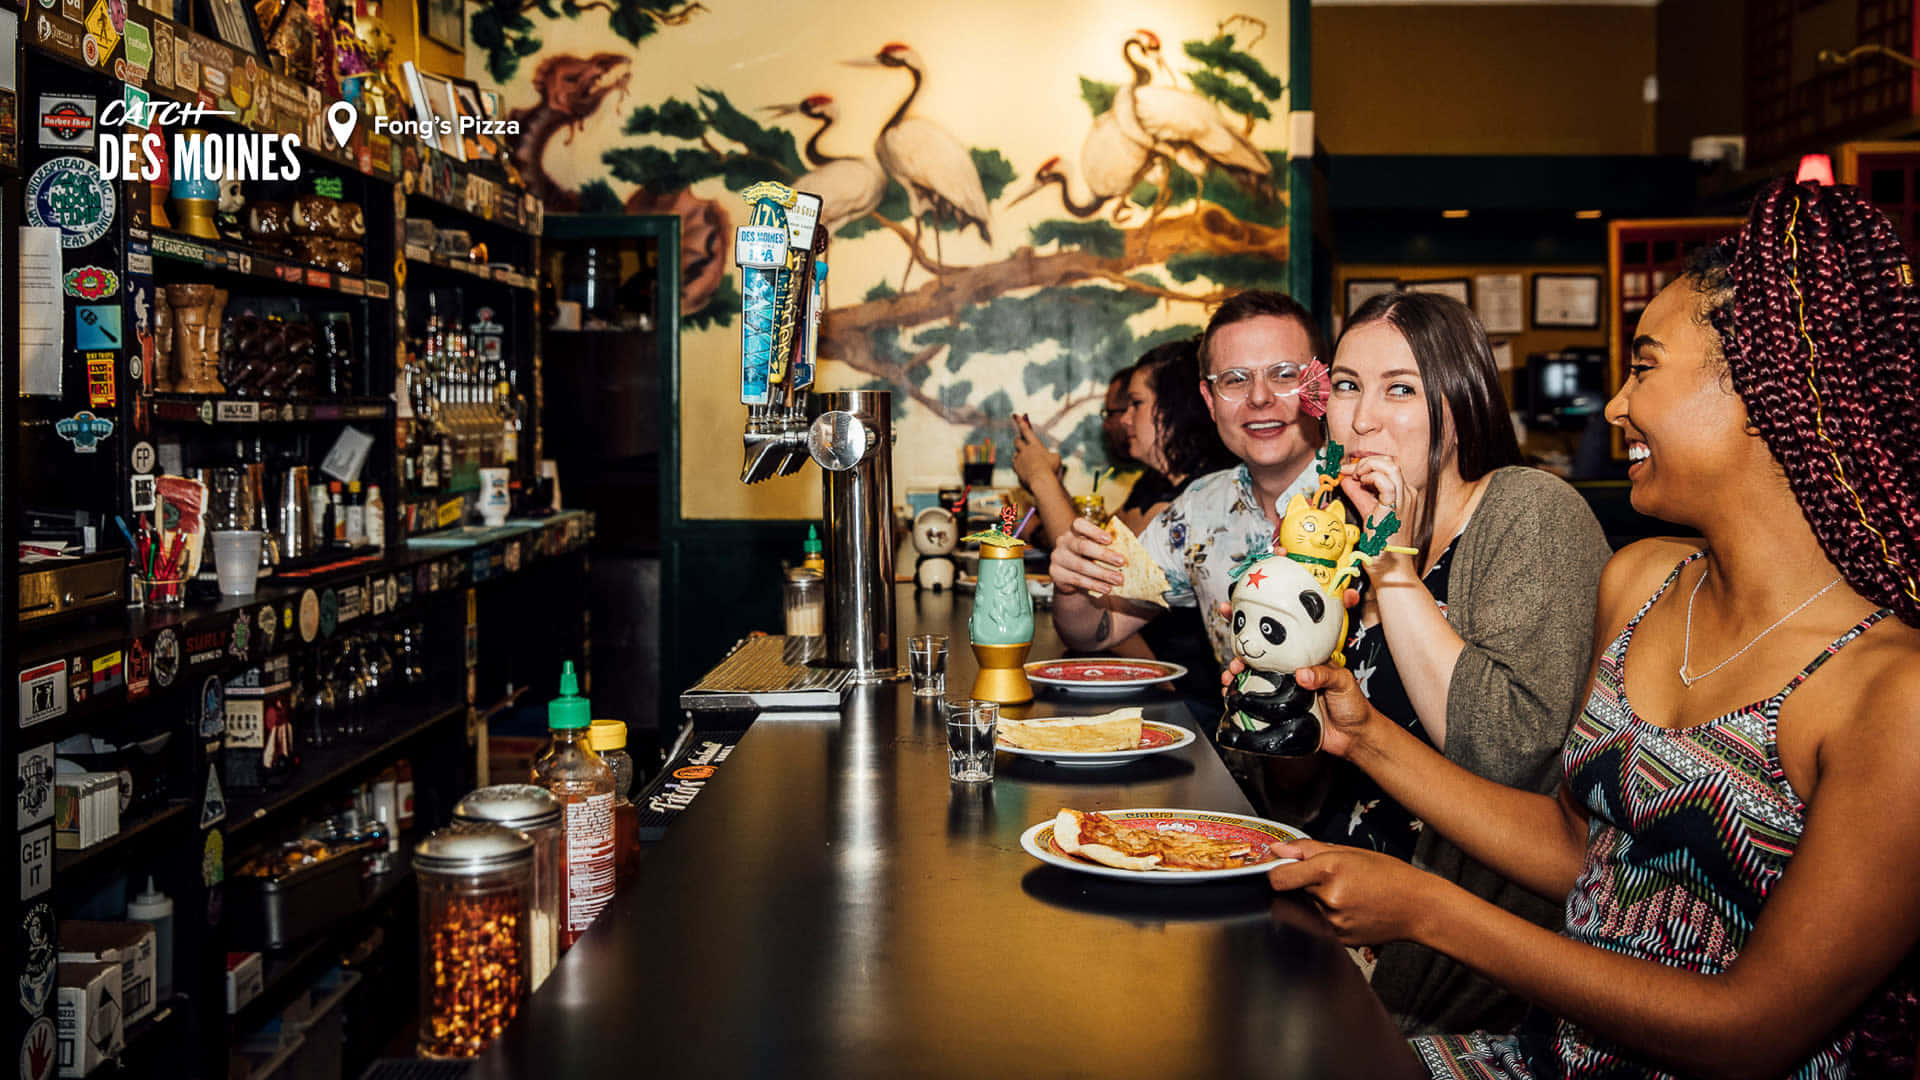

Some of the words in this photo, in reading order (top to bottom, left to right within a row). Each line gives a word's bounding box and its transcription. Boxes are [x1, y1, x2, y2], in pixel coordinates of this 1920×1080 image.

[28, 158, 86, 195] WIDESPREAD
[88, 210, 113, 240] PANIC
[741, 230, 755, 242] DES
[757, 231, 785, 245] MOINES
[749, 248, 774, 262] IA
[136, 447, 150, 469] FP
[22, 836, 50, 864] GET
[30, 863, 42, 887] IT
